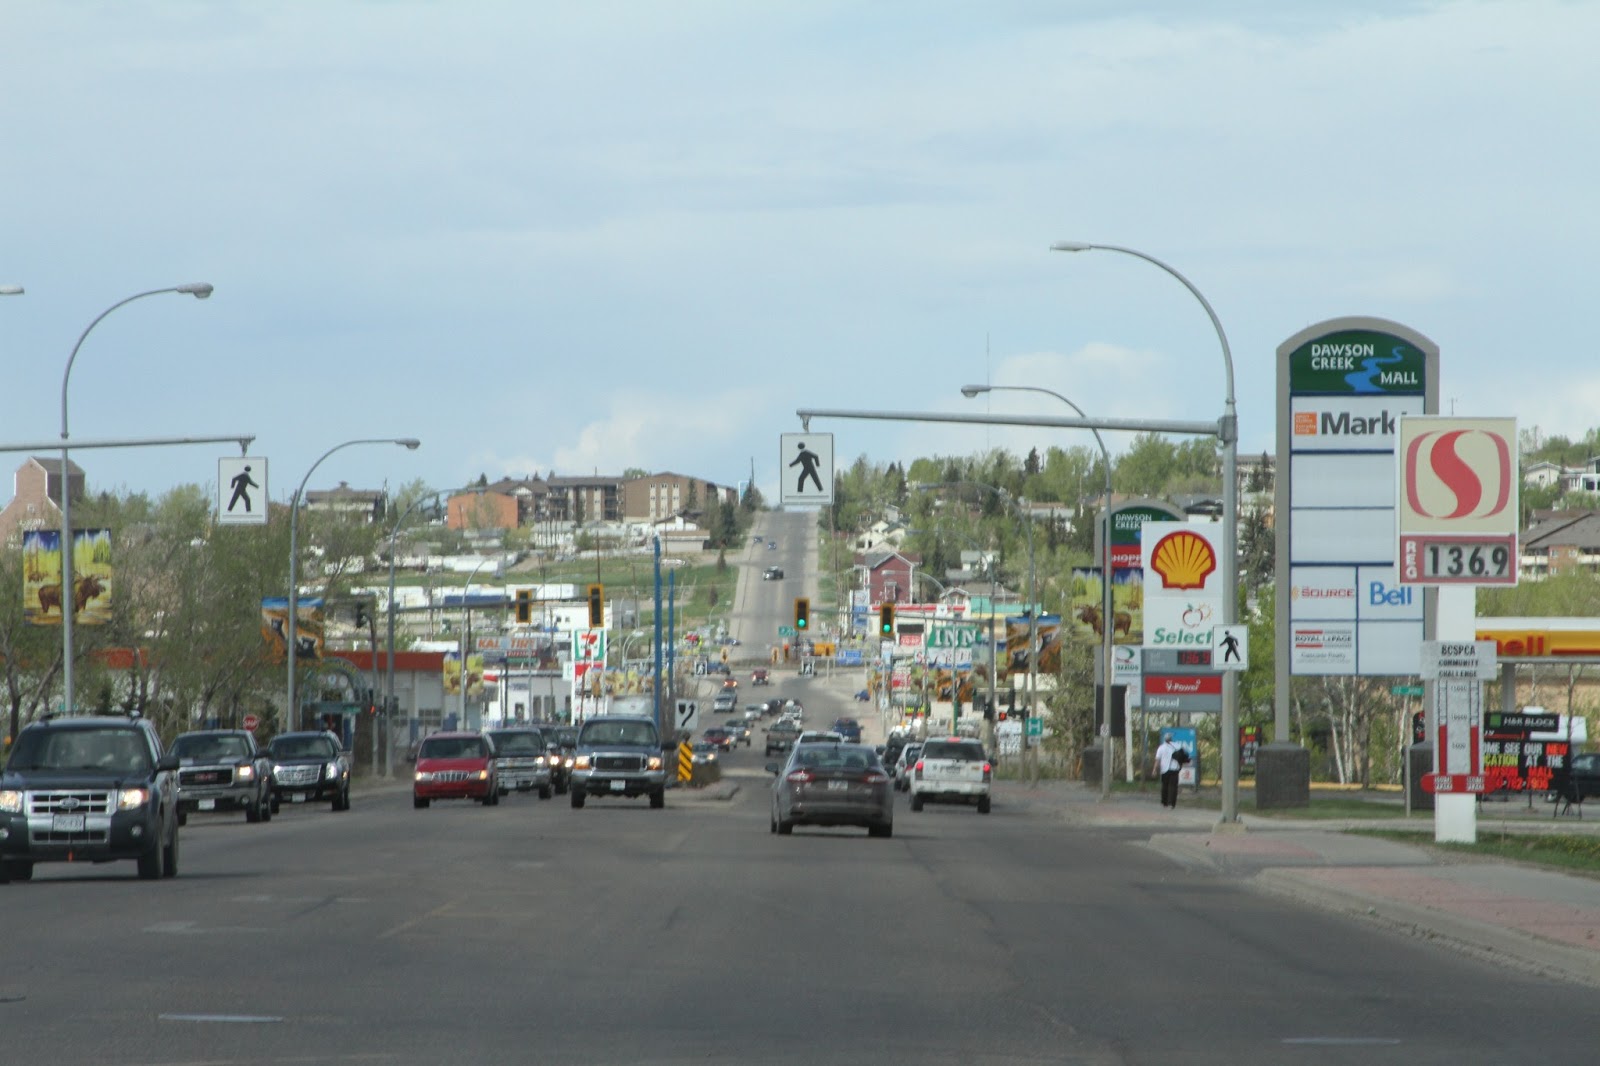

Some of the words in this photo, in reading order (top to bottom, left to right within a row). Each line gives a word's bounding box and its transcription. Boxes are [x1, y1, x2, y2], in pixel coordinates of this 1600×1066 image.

[1311, 343, 1374, 357] DAWSON
[1311, 357, 1354, 370] CREEK
[1380, 371, 1418, 384] MALL
[1321, 410, 1396, 435] Mark
[1115, 513, 1152, 521] DAWSON
[1115, 521, 1141, 529] CREEK
[1429, 545, 1509, 576] 136.9
[1301, 587, 1355, 598] SOURCE
[1370, 581, 1412, 606] Bell
[934, 629, 976, 647] INN
[1153, 627, 1213, 645] Select
[1438, 659, 1479, 668] COMMUNITY
[1149, 697, 1180, 708] Diesel
[1524, 718, 1556, 728] BLOCK
[1504, 742, 1521, 754] SEE
[1523, 742, 1543, 756] OUR
[1545, 743, 1569, 756] NEW
[1484, 754, 1519, 767] CATION
[1525, 755, 1540, 767] AT
[1546, 755, 1564, 768] THE
